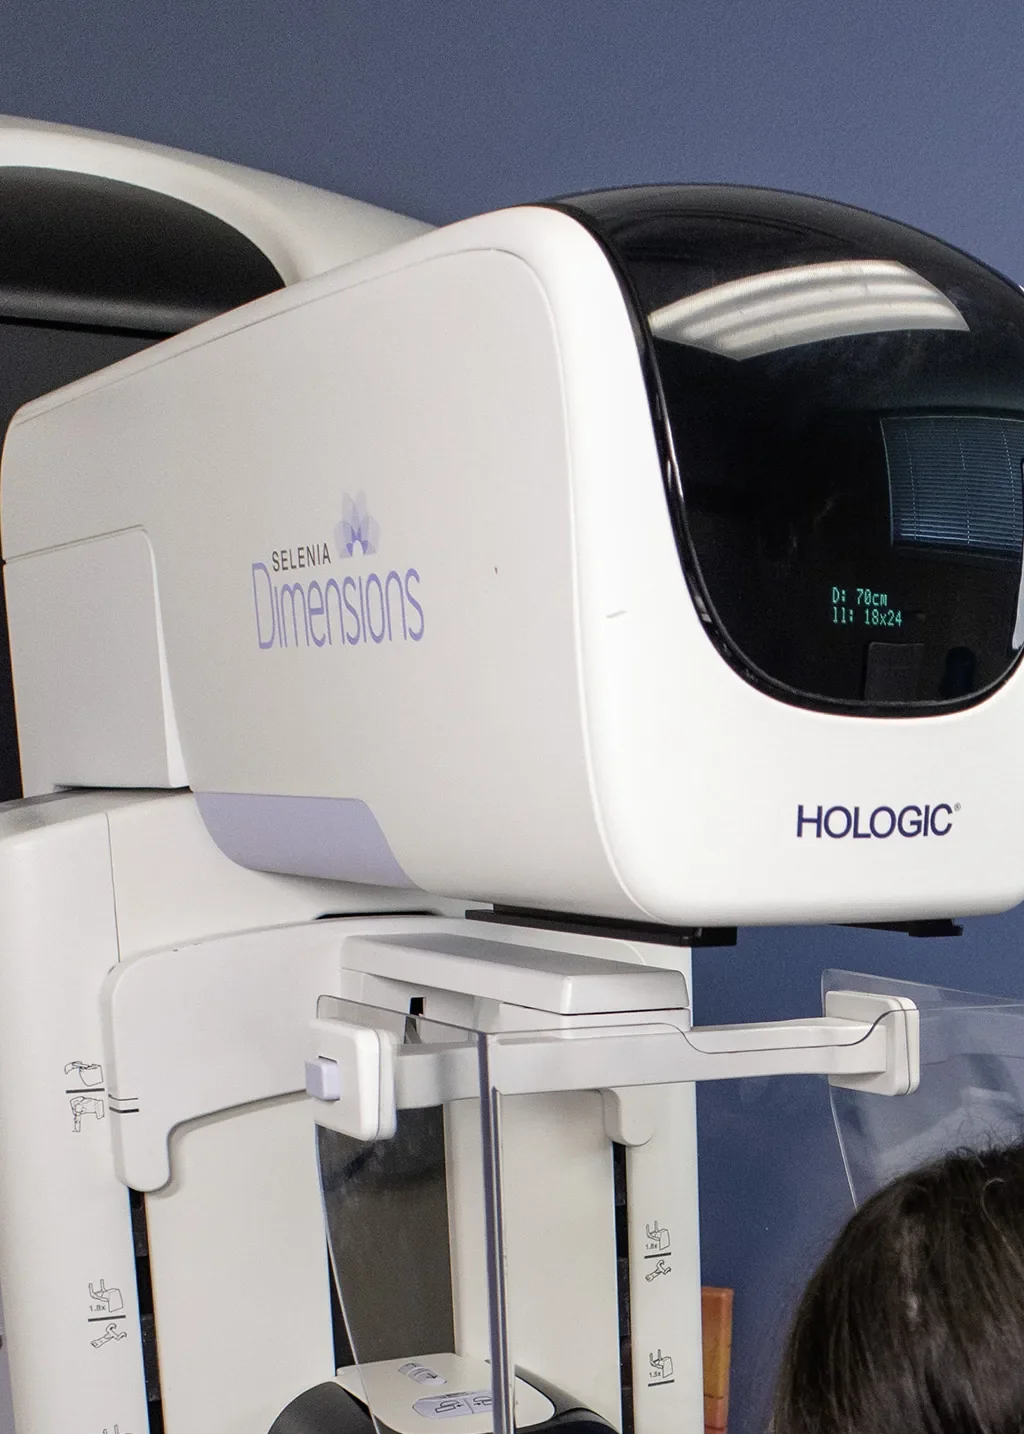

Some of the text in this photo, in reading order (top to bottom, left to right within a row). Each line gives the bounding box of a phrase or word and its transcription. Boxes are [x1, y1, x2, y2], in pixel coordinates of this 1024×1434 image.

[271, 542, 332, 572] SELENIA
[252, 562, 425, 650] Dimensions
[856, 587, 888, 607] 70cm
[864, 608, 902, 627] 18x24
